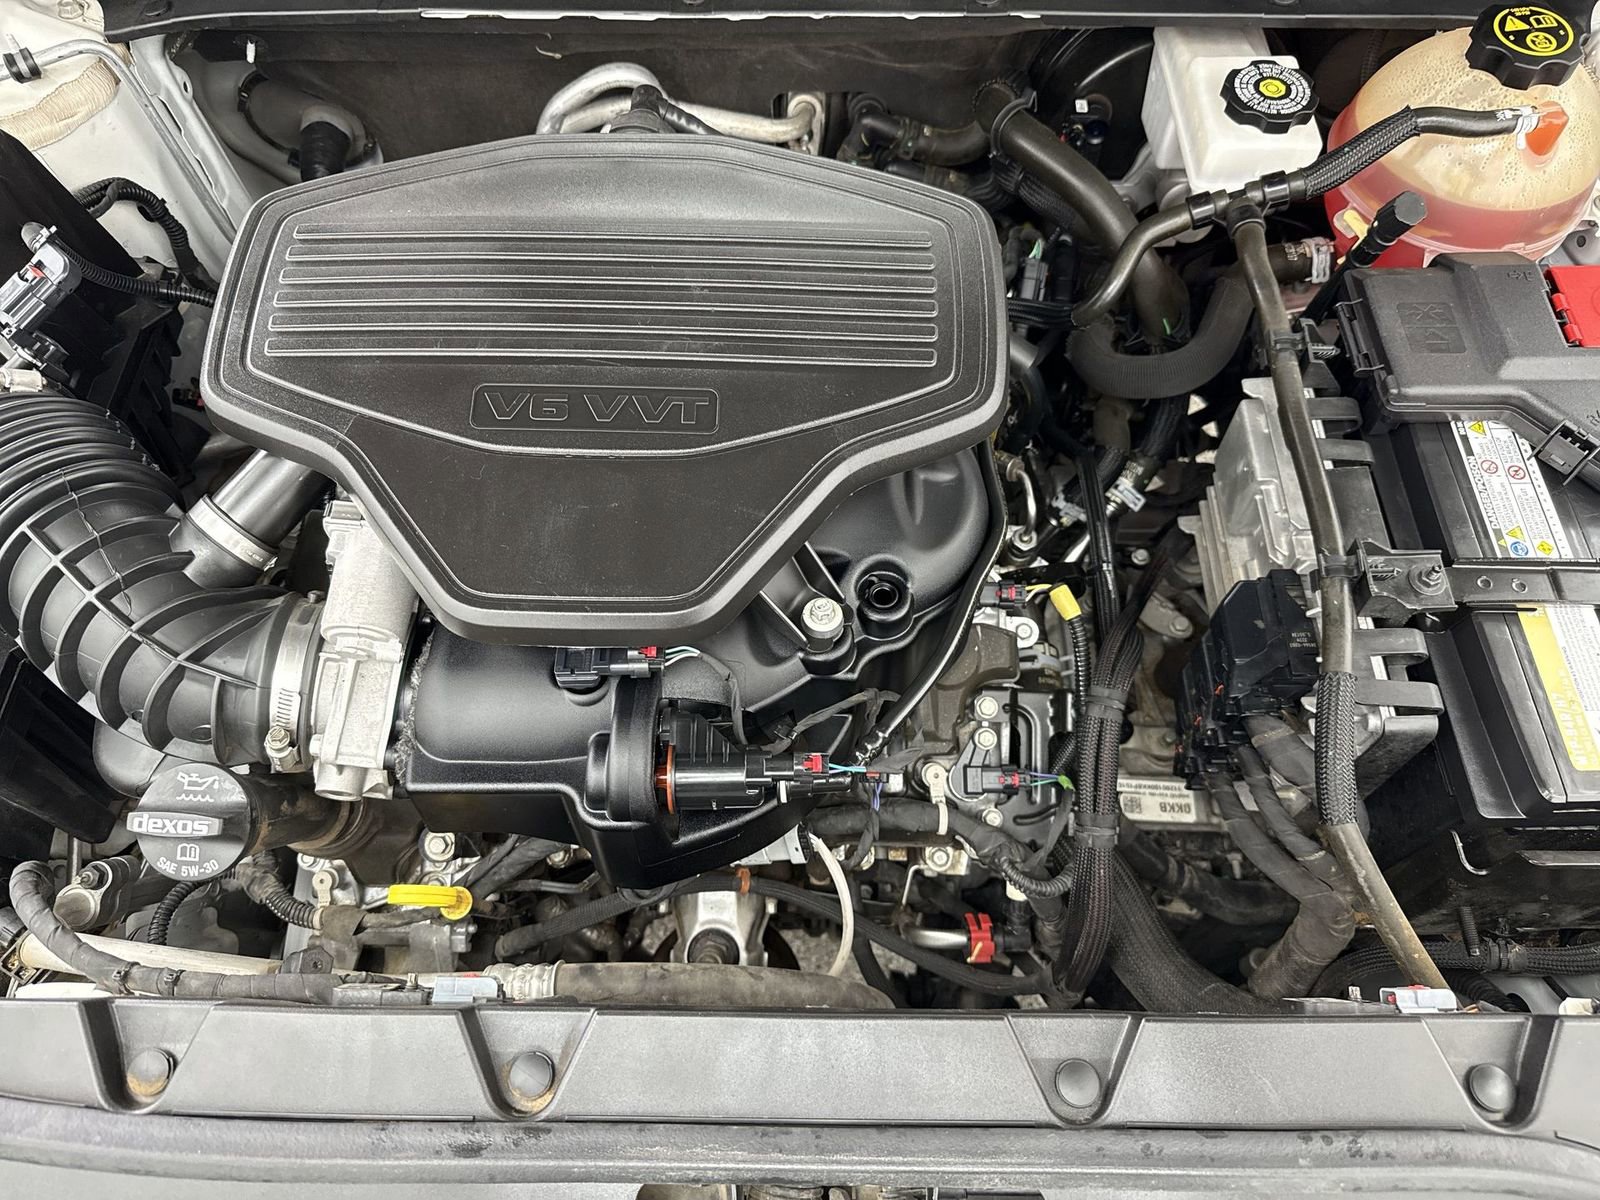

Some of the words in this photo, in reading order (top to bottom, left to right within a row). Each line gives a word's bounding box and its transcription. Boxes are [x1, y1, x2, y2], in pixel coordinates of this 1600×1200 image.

[484, 392, 569, 421] V6
[583, 394, 709, 424] VVT
[1466, 456, 1501, 528] DANGER/POISON
[133, 814, 210, 834] dexos
[157, 857, 178, 874] SAE
[181, 859, 219, 877] 5W-30
